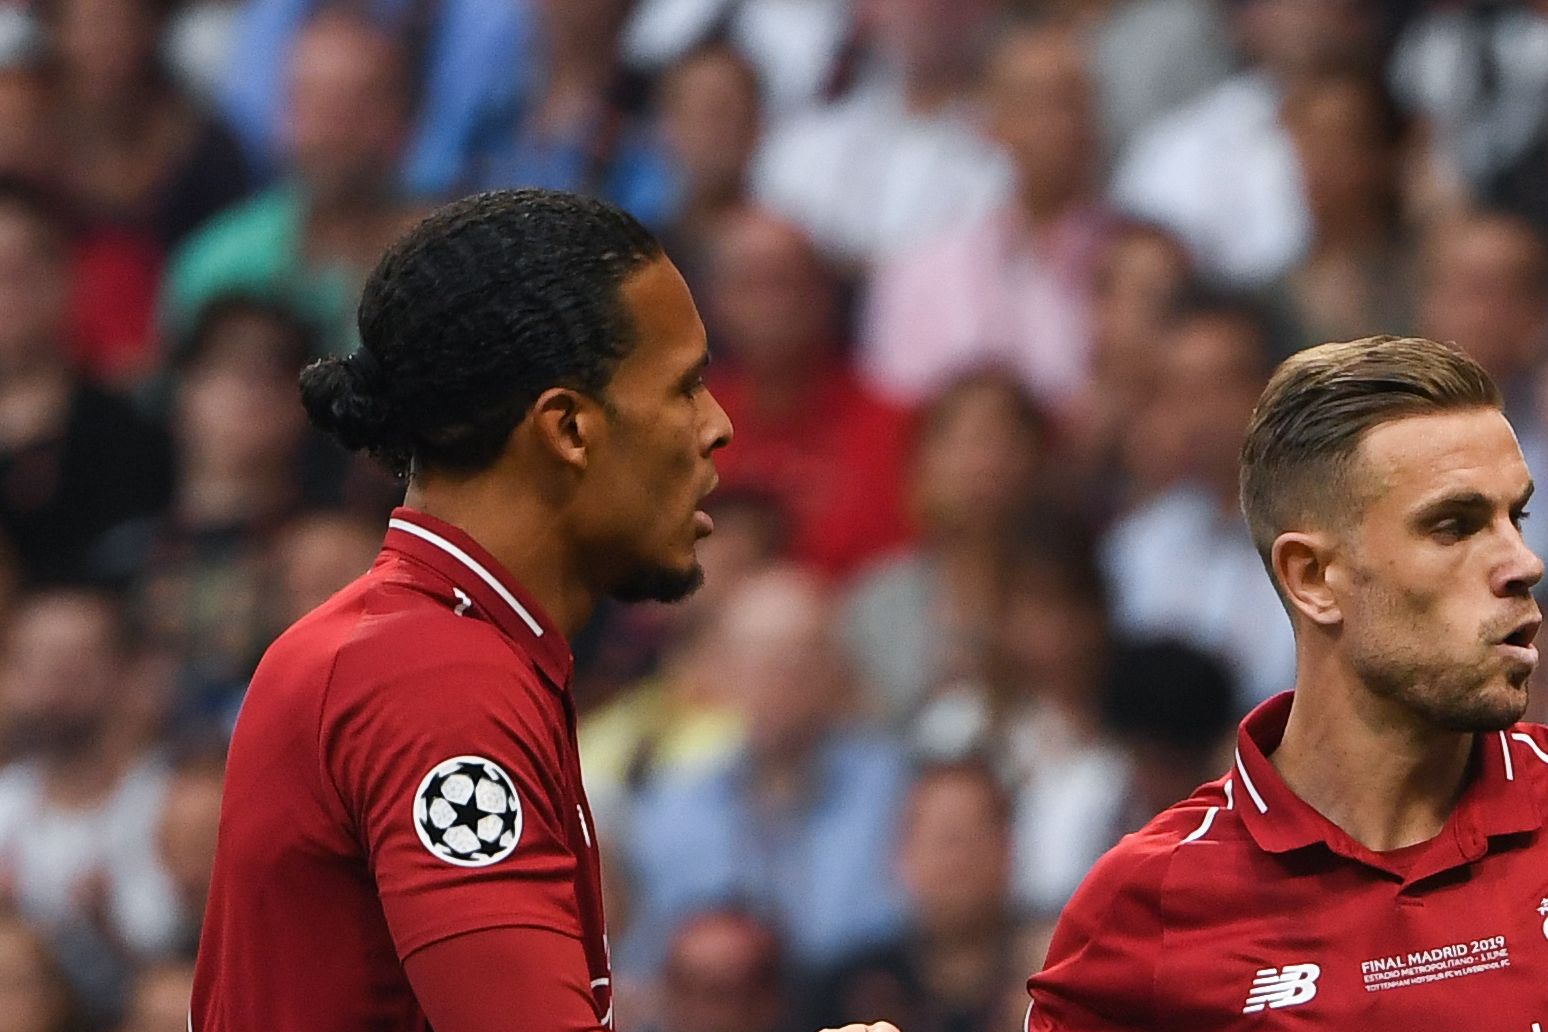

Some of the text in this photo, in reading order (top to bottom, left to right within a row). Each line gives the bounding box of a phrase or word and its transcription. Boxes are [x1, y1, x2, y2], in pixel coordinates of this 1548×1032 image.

[1361, 935, 1505, 974] FINAL MADRID 2019
[1363, 969, 1400, 983] ESTADIO
[1401, 956, 1474, 977] METROPOLITANO
